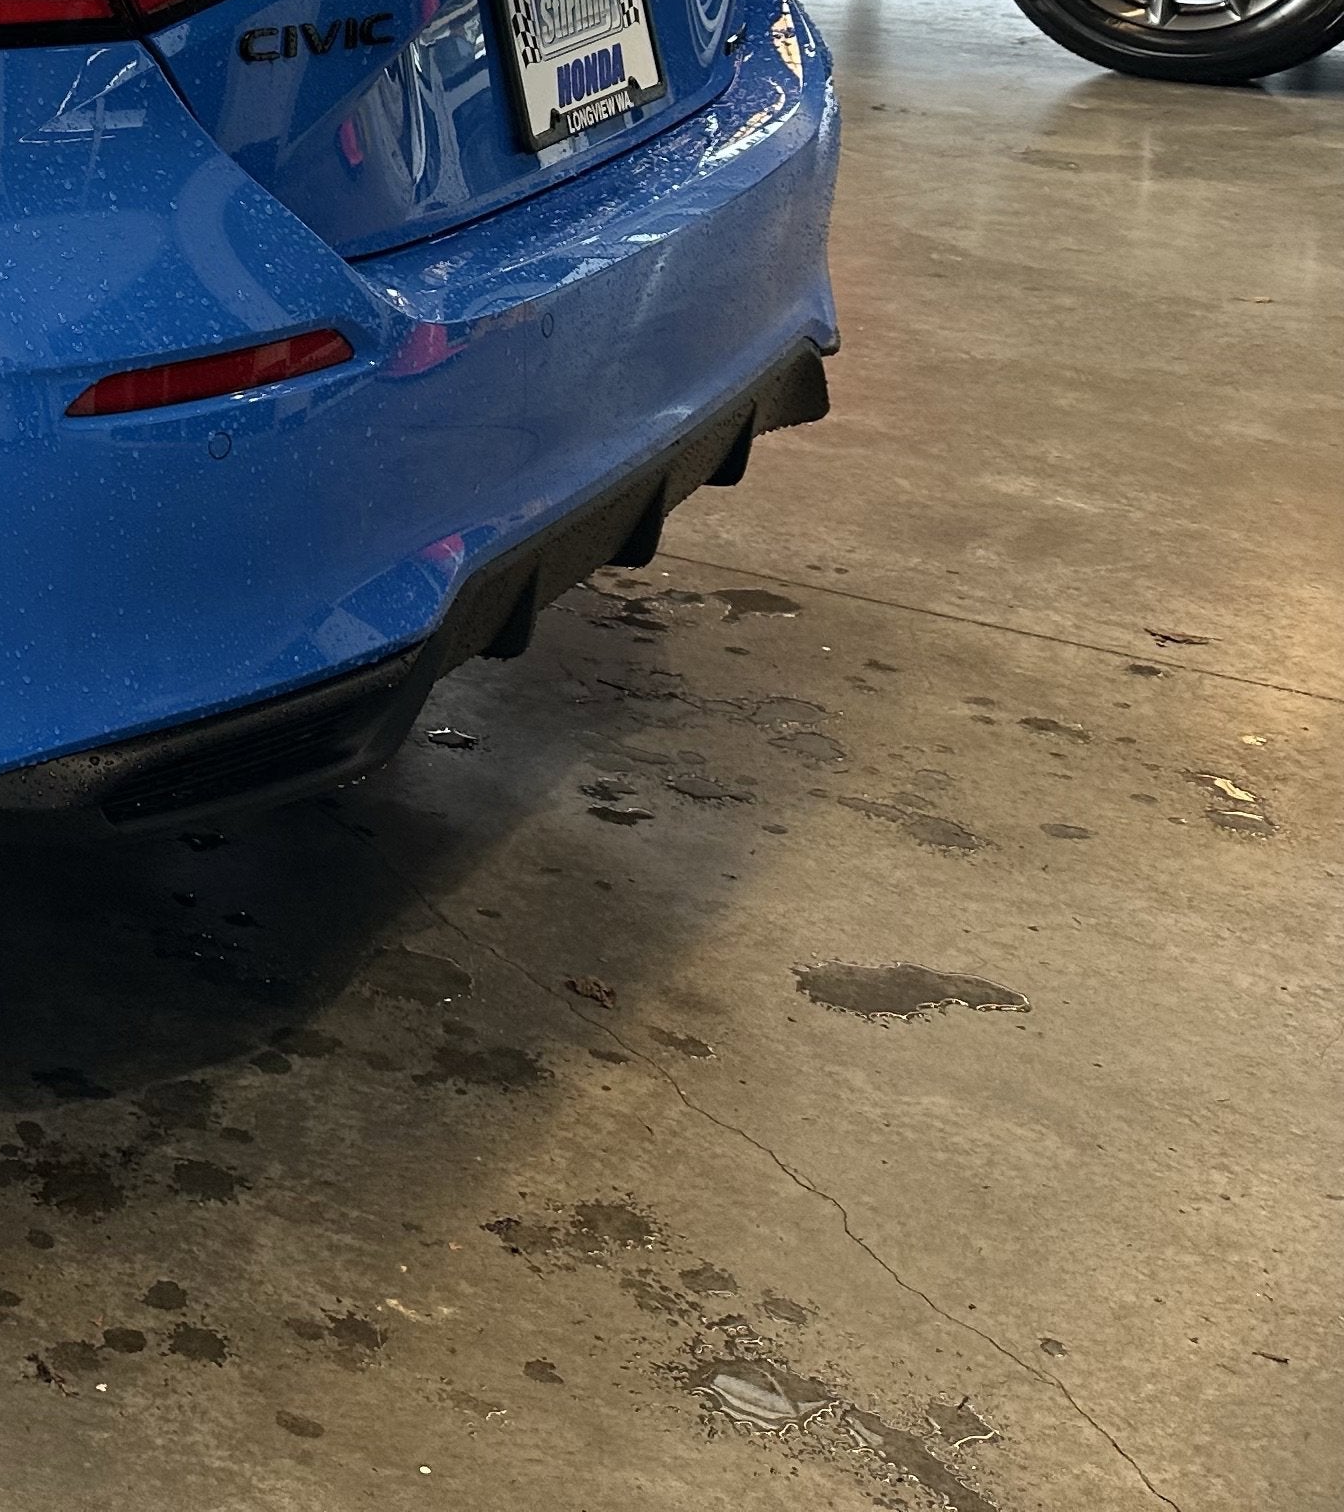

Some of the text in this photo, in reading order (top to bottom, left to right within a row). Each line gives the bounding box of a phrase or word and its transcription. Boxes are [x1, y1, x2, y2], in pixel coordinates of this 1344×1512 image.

[239, 12, 394, 63] CIVIC
[556, 43, 626, 107] HONDA
[566, 96, 616, 134] LONGVIEW
